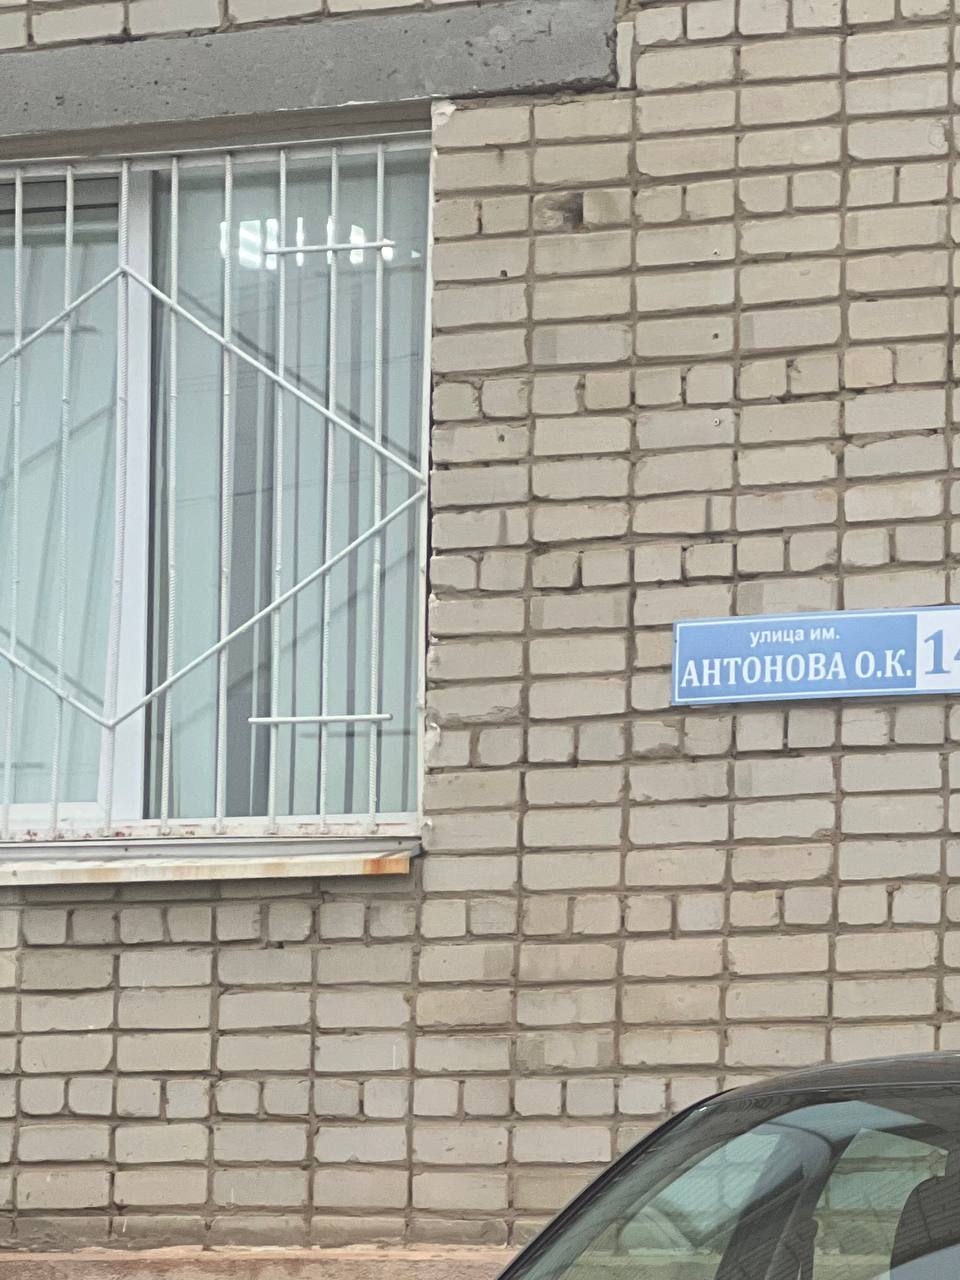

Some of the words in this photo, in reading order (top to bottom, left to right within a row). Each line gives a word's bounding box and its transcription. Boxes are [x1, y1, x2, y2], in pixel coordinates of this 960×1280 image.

[750, 628, 804, 647] улица
[810, 627, 840, 641] им.
[681, 652, 847, 687] АНТОНОВА
[855, 649, 912, 678] О.К.
